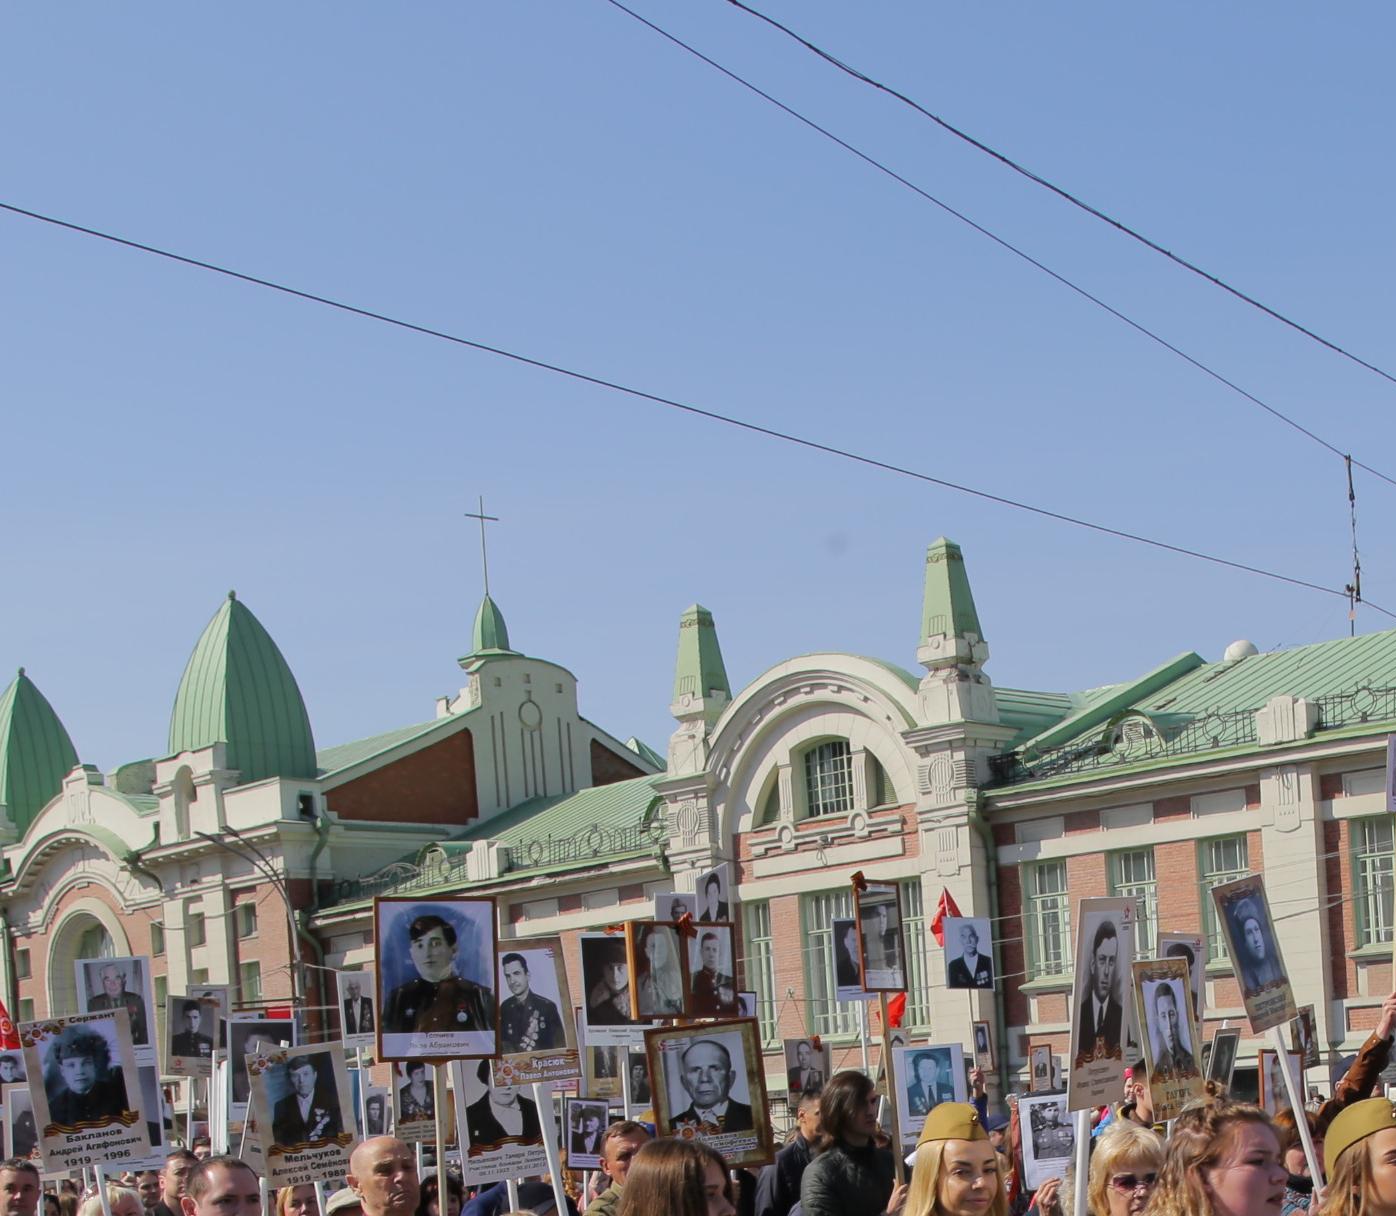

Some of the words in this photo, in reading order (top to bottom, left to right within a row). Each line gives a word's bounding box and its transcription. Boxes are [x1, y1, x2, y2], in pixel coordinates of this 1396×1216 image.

[69, 1011, 116, 1024] Сержант
[532, 1059, 565, 1070] Красюк
[66, 1128, 123, 1143] Бакланов
[50, 1144, 83, 1157] Андрей
[85, 1136, 142, 1151] Агафонович
[64, 1156, 91, 1168] 1919
[103, 1150, 131, 1161] 1996
[284, 1148, 341, 1163] Мельчуков
[272, 1165, 308, 1177] Алексей
[287, 1174, 311, 1185] 1919
[322, 1168, 346, 1179] 1989
